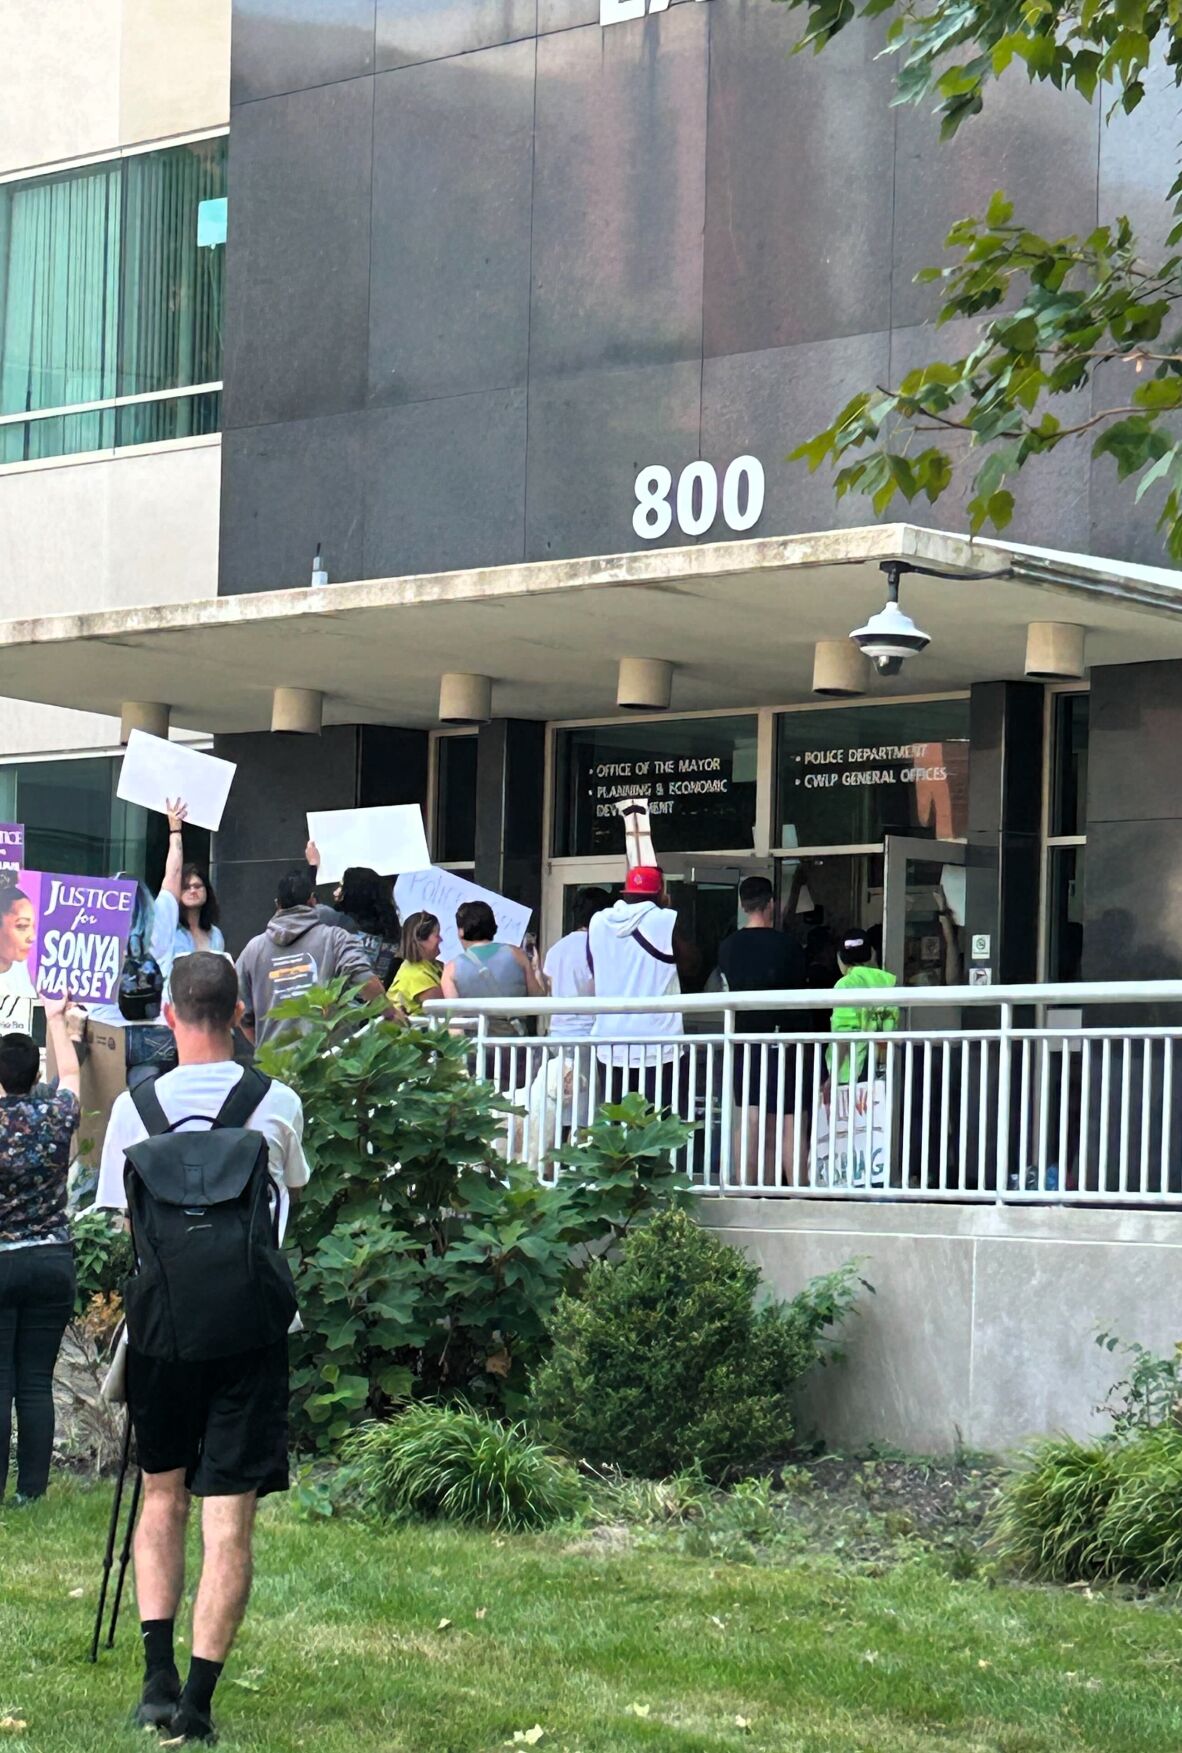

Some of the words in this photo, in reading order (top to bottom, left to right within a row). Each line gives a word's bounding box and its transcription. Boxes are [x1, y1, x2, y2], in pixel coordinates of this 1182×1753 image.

[632, 455, 765, 540] 800
[804, 749, 844, 765] POLICE
[848, 743, 928, 762] DEPARTMENT
[597, 763, 632, 777] OFFICE
[635, 761, 650, 775] OF
[654, 760, 674, 774] THE
[679, 757, 721, 773] MAYOR
[804, 773, 839, 788] CWLP
[841, 770, 897, 786] GENERAL
[900, 767, 948, 783] OFFICES
[597, 783, 652, 799] PLANNING
[668, 779, 728, 795] ECONOMIC
[70, 907, 98, 931] for
[41, 929, 120, 974] SONYA
[37, 965, 118, 999] MASSEY
